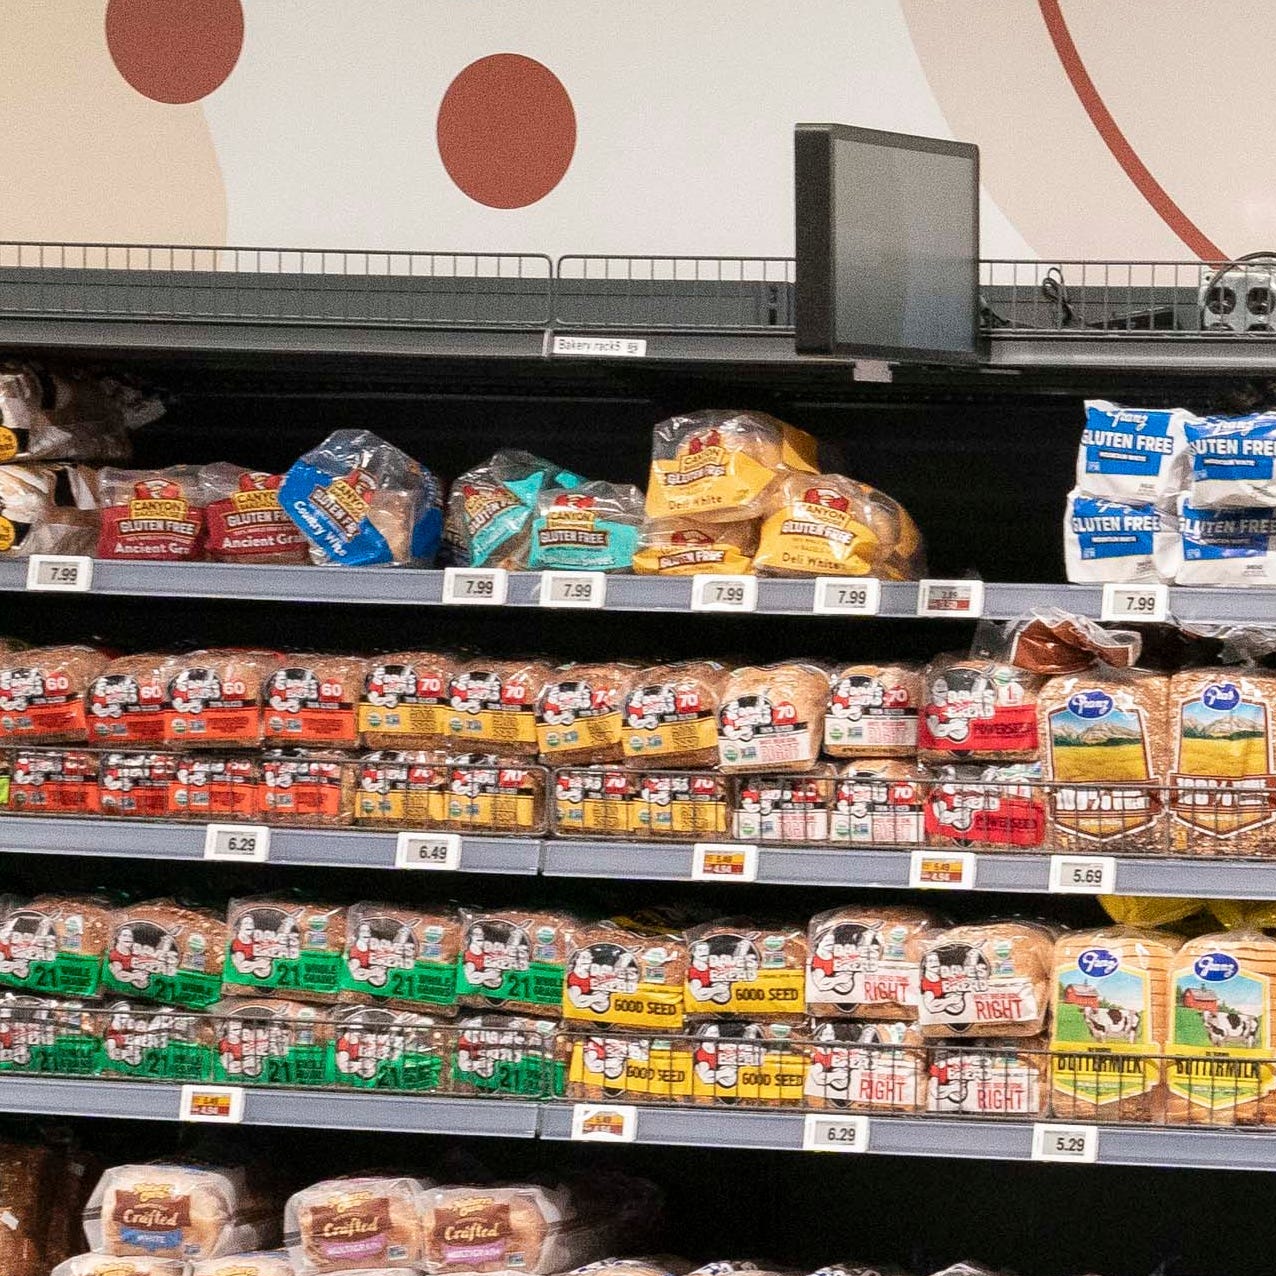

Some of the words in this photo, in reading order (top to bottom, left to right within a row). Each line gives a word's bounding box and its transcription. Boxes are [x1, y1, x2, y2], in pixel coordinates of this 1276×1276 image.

[50, 566, 78, 584] 7.99
[466, 578, 494, 595] 7.99
[563, 581, 592, 599] 7.99
[716, 586, 743, 602] 7.99
[838, 589, 866, 605] 7.99
[1126, 596, 1155, 612] 7.99
[227, 835, 256, 853] 6.29
[419, 844, 447, 861] 6.49
[1073, 868, 1102, 883] 5.69
[768, 988, 799, 1002] SEED
[864, 981, 906, 1003] RIGHT
[976, 999, 1022, 1020] RIGHT
[827, 1126, 856, 1142] 6.29
[1056, 1136, 1085, 1153] 5.29
[123, 1206, 179, 1227] Crafted
